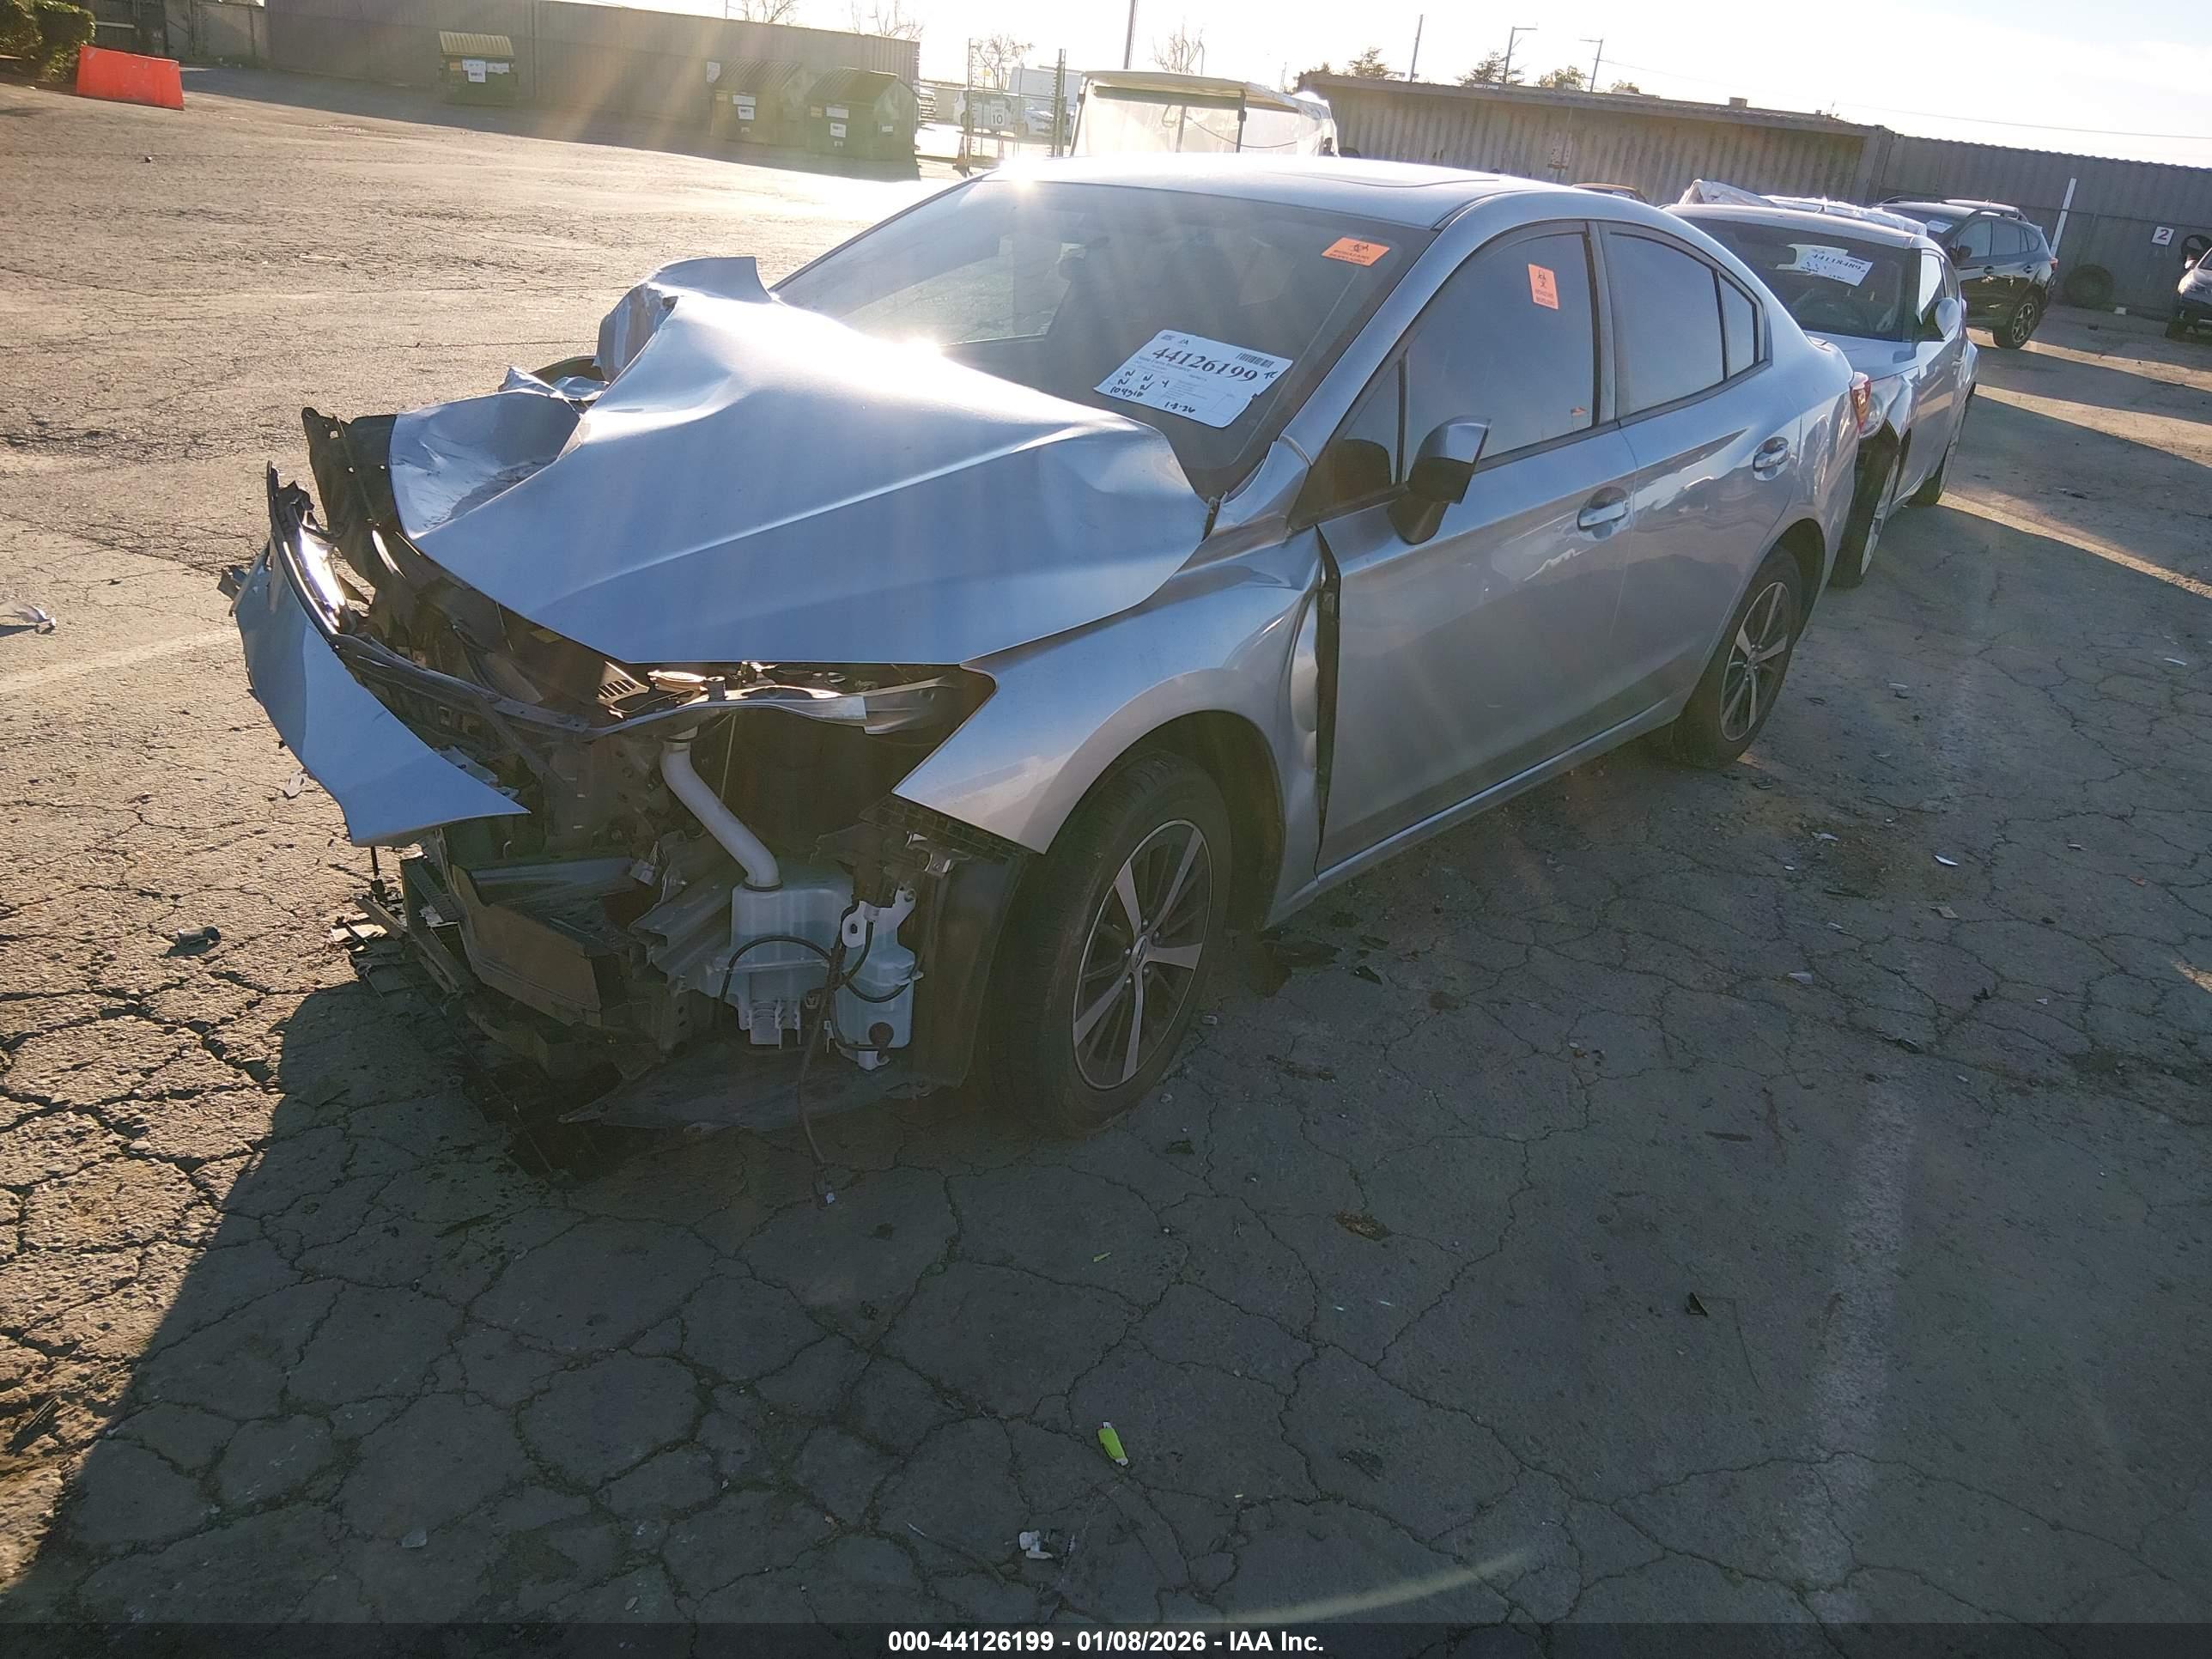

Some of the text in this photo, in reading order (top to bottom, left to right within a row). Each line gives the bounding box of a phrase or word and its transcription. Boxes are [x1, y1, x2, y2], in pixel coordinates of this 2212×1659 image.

[993, 114, 1003, 125] 10
[2157, 228, 2169, 240] 2
[1152, 347, 1258, 382] 44126199
